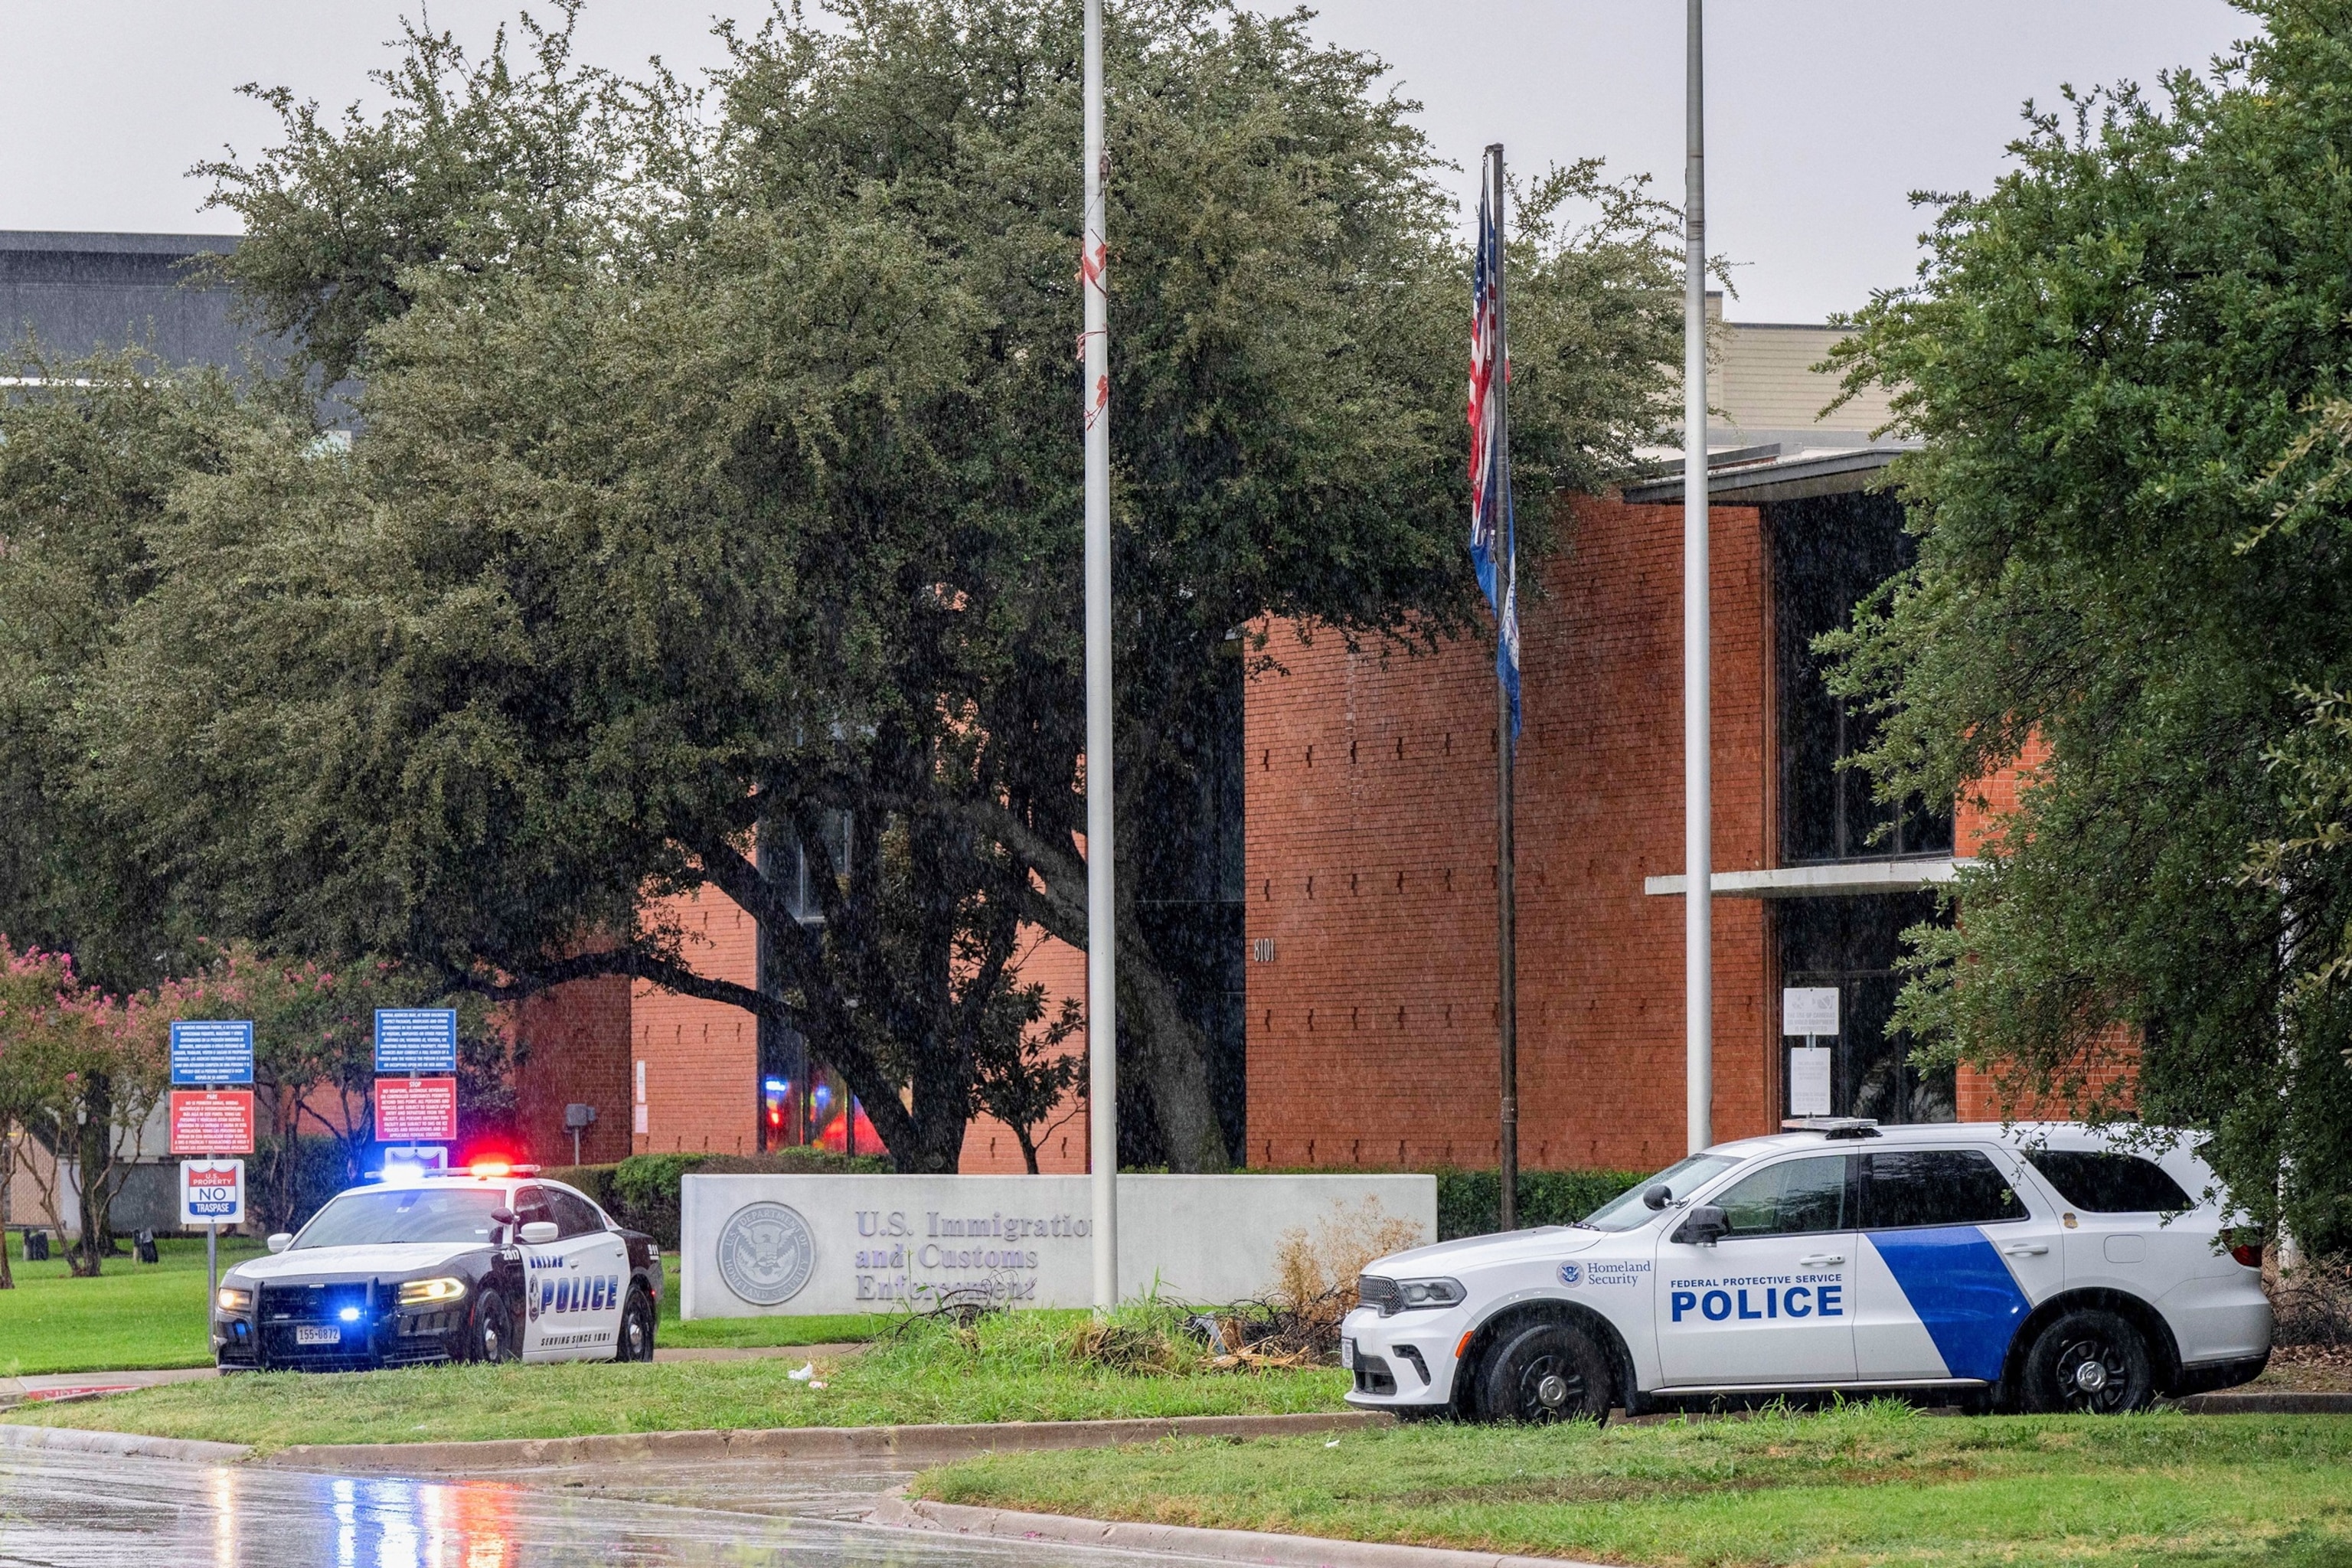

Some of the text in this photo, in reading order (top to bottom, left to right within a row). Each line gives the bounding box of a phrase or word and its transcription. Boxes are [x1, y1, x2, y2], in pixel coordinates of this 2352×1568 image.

[1255, 938, 1274, 962] 8101
[200, 1187, 226, 1200] NO
[195, 1203, 229, 1213] TRASPASE
[740, 1210, 801, 1233] DEPARTMENT
[799, 1234, 808, 1249] OF
[855, 1211, 1093, 1242] U.S. Immigratio
[501, 1250, 519, 1260] 2017
[855, 1243, 1038, 1269] and Customs
[528, 1256, 564, 1269] DALLAS
[1587, 1260, 1651, 1273] Homeland
[725, 1259, 808, 1298] HOMELAND SECURITY
[1589, 1273, 1638, 1287] Security
[1671, 1274, 1842, 1288] FEDERAL PROTECTIVE SERVICE
[541, 1275, 619, 1315] POLICE
[1671, 1285, 1844, 1322] POLICE
[541, 1332, 610, 1346] SERVING SINCE 1881
